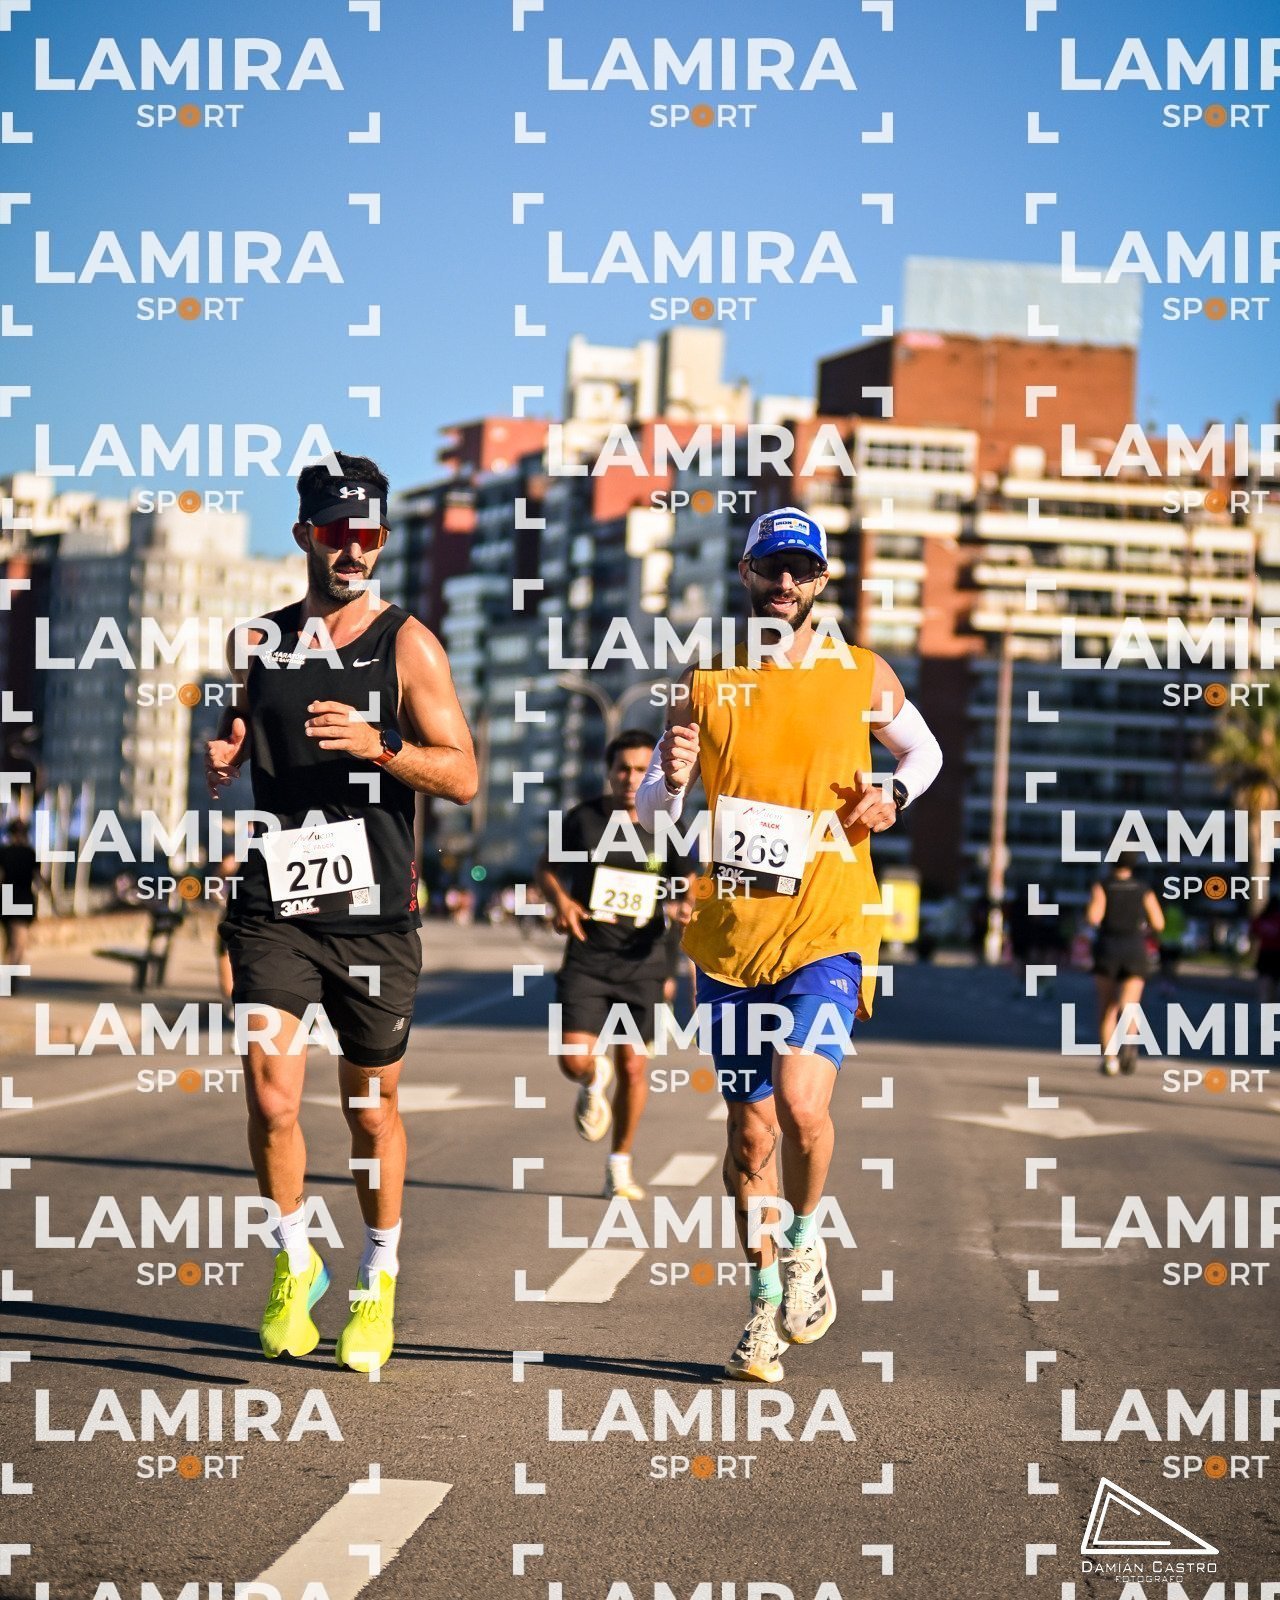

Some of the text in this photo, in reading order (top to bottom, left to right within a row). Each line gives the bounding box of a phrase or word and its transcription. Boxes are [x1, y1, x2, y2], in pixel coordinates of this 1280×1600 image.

[727, 830, 789, 868] 269
[287, 854, 353, 892] 270
[280, 897, 315, 917] 30K
[603, 888, 642, 911] 238
